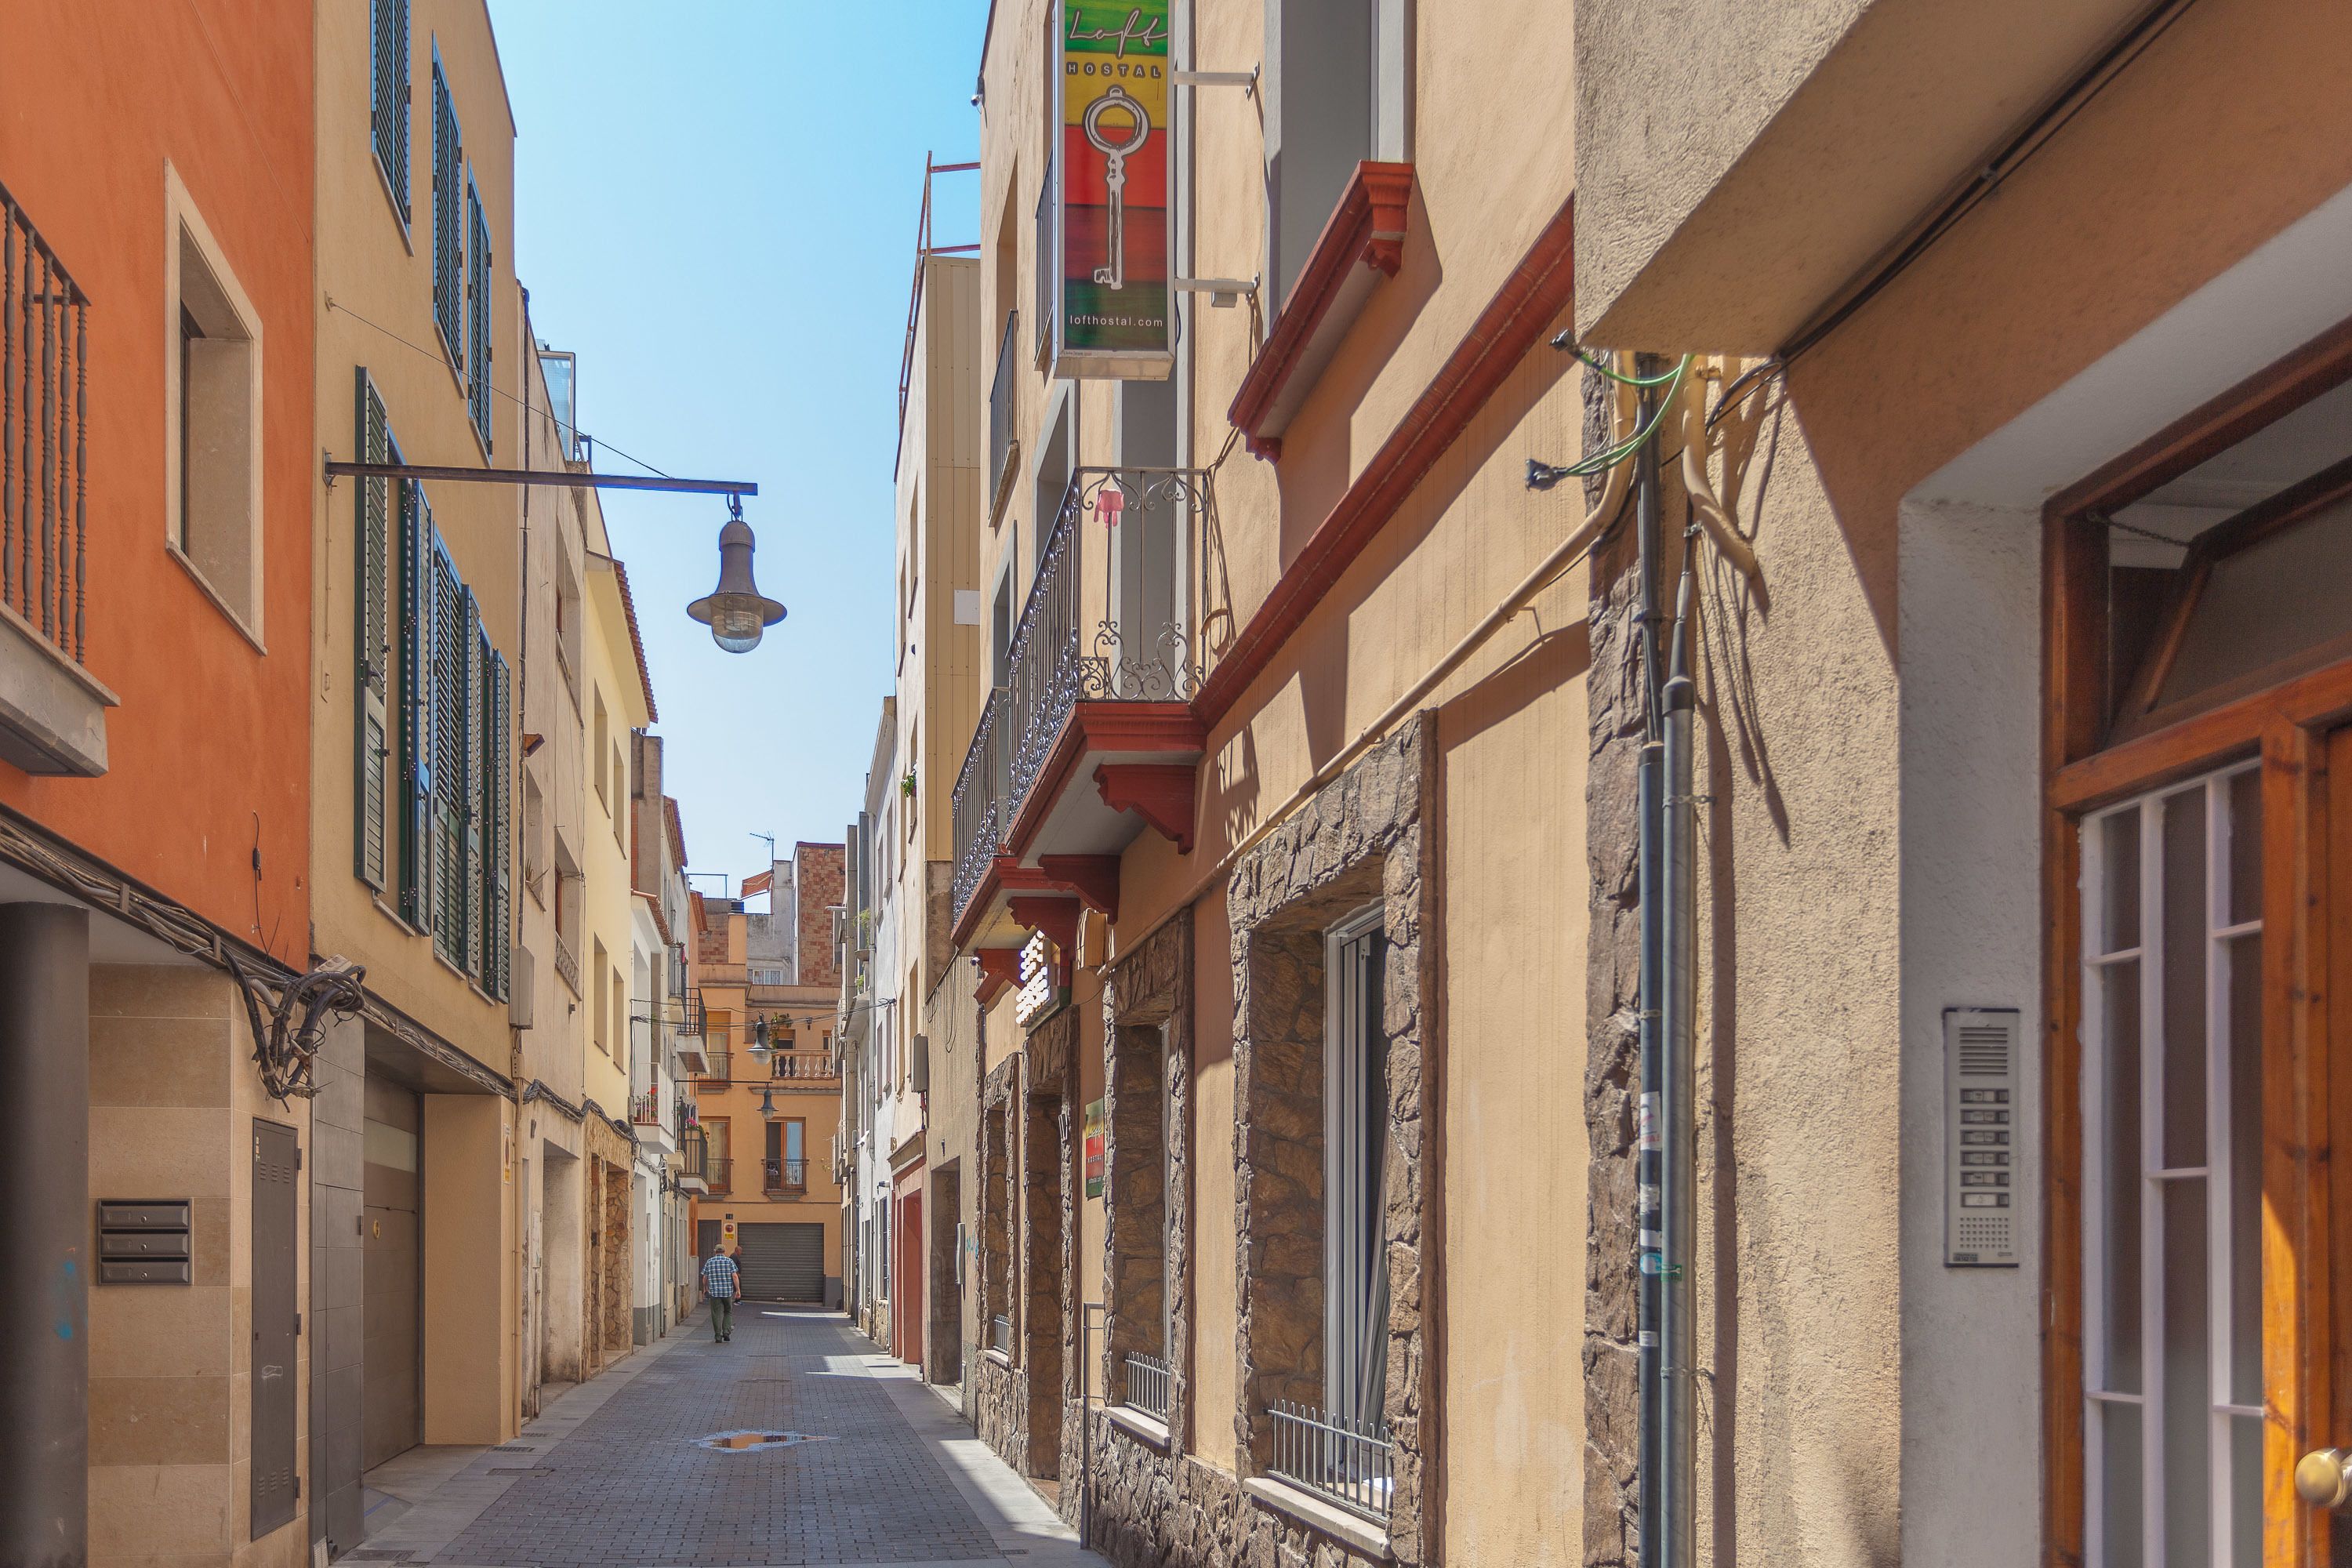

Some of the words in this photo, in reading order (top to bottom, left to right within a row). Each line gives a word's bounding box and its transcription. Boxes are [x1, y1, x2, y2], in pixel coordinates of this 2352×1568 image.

[1069, 9, 1168, 57] Loft
[1069, 64, 1160, 77] HOSTAL
[1069, 314, 1163, 327] lofthostal.com
